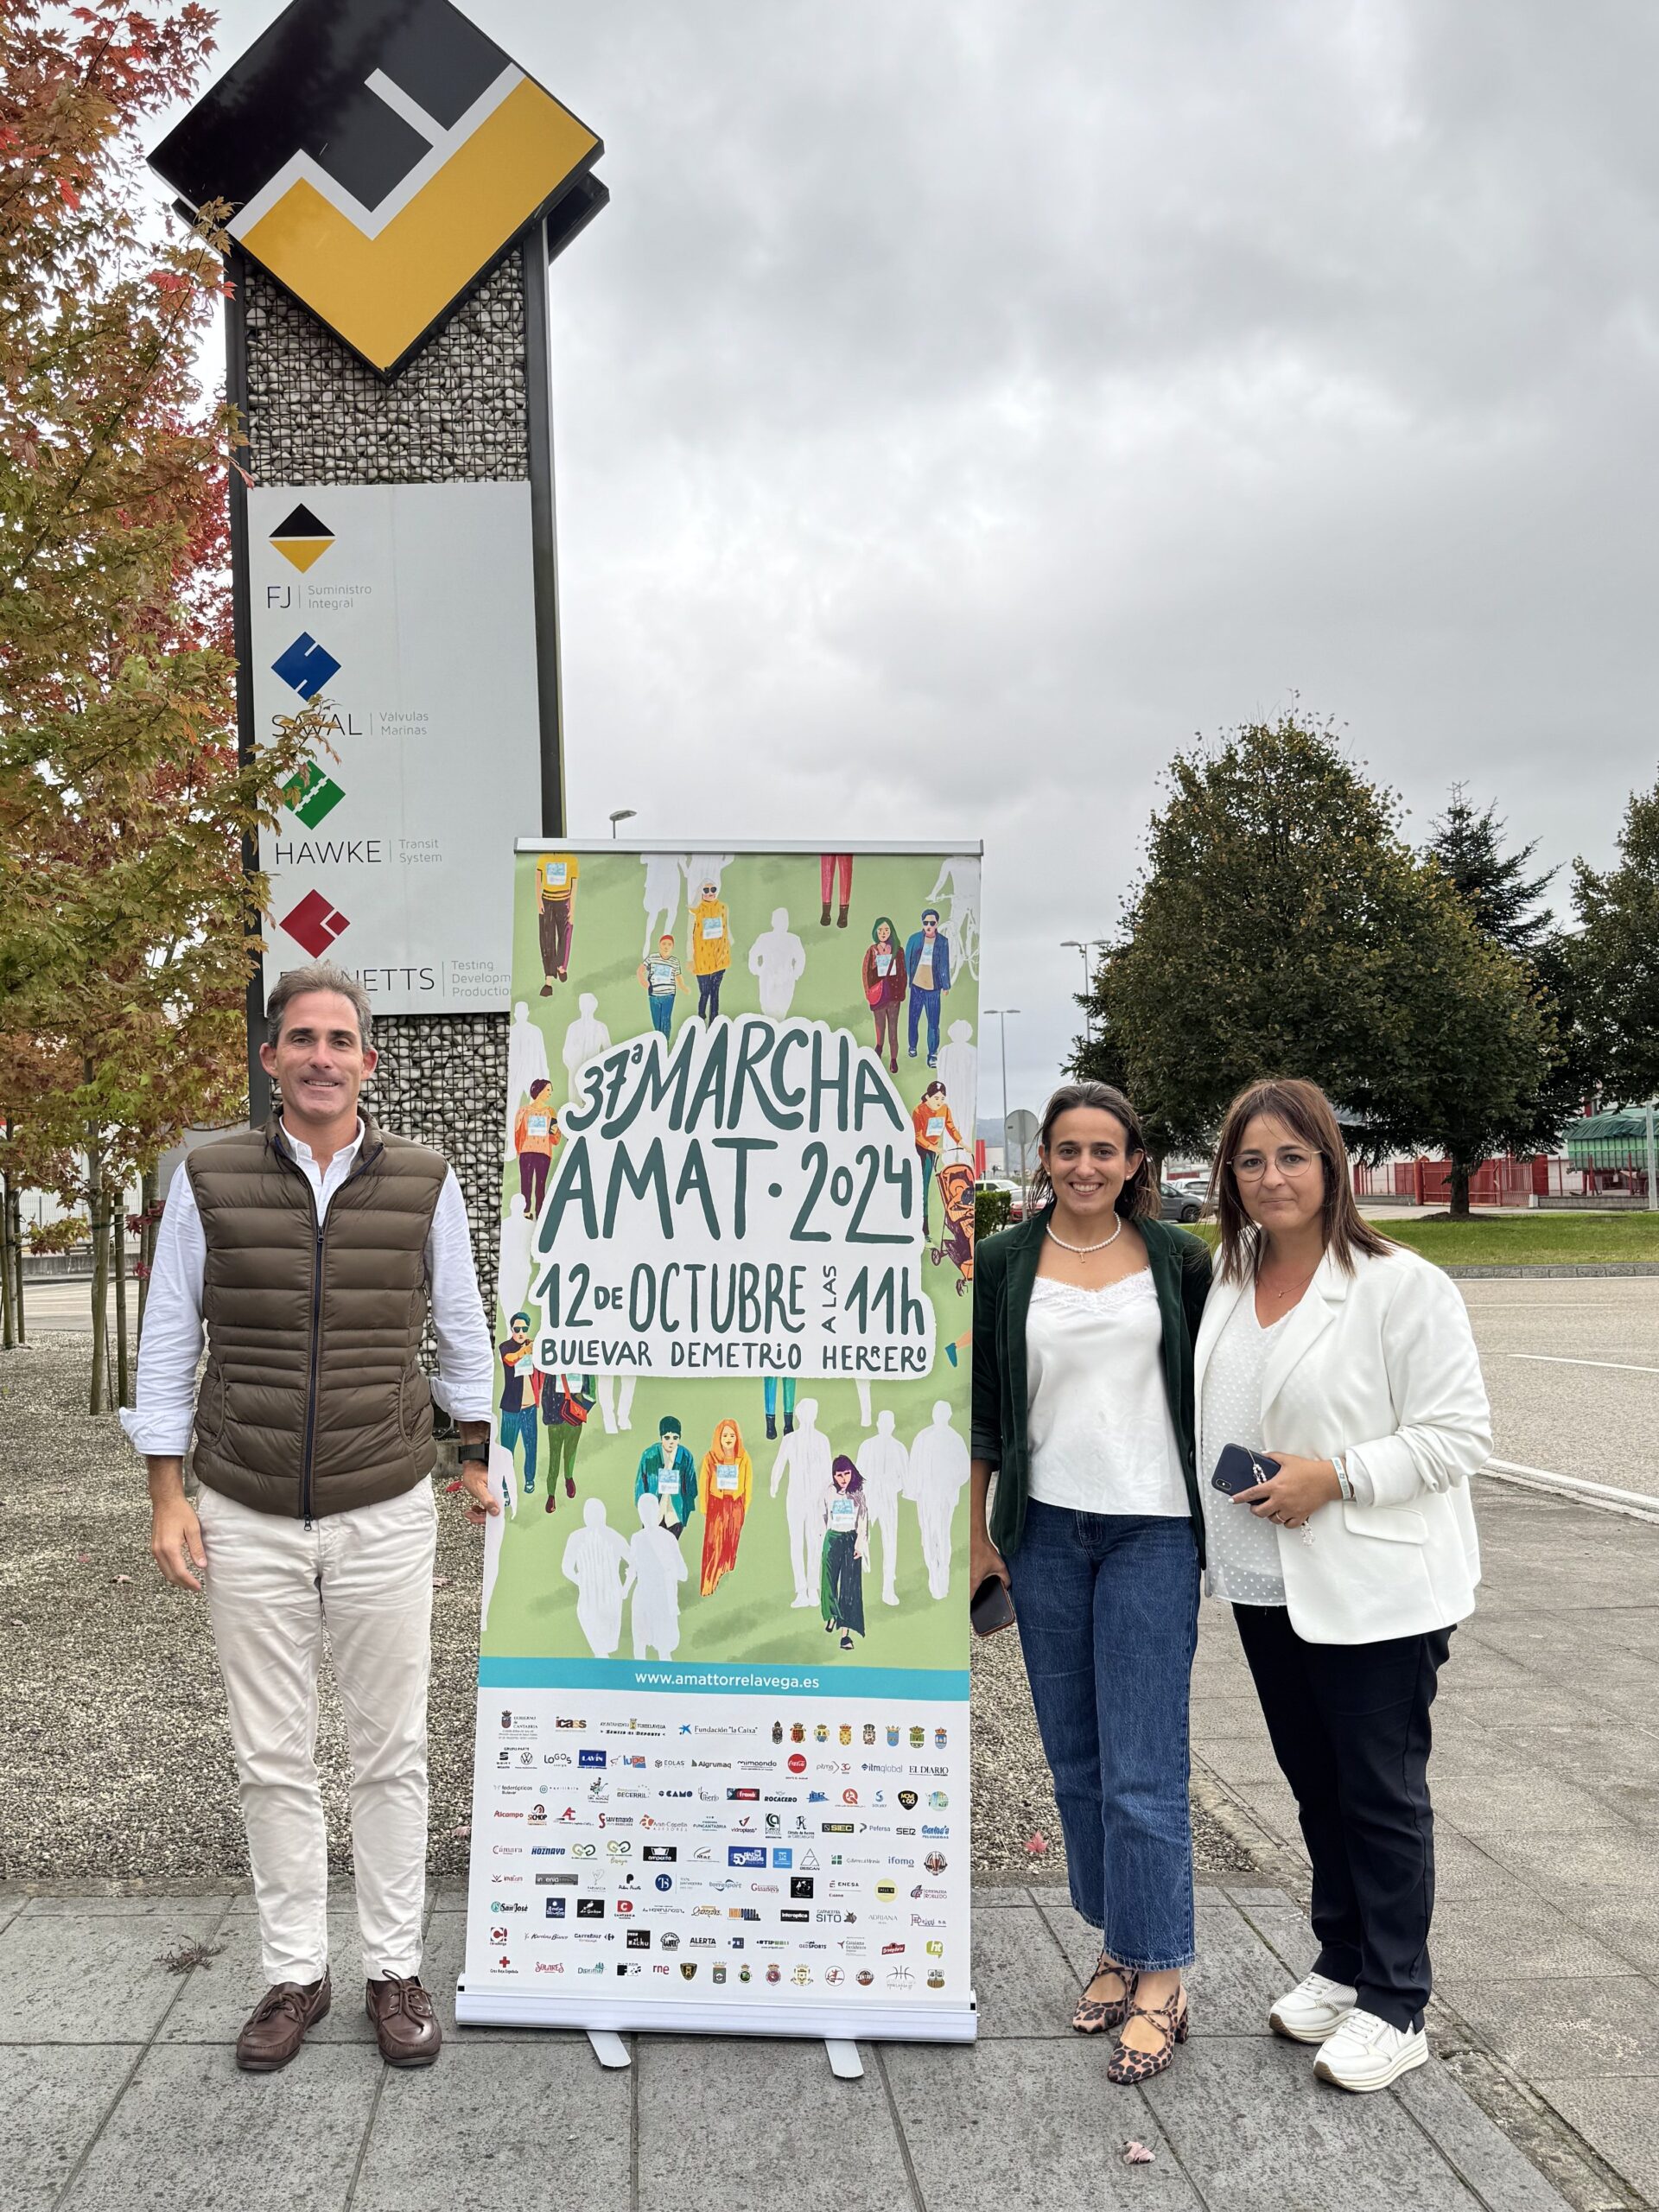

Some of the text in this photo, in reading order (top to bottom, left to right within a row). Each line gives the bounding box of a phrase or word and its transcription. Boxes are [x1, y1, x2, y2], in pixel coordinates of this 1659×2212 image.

[308, 585, 372, 594] Suministro
[267, 586, 290, 608] FJ
[308, 598, 353, 610] Integral
[379, 711, 429, 721] Válvulas
[381, 725, 428, 735] Marinas
[398, 839, 439, 849] Transit
[276, 840, 382, 865] HAWKE
[399, 853, 442, 865] System
[451, 960, 493, 971] Testing
[452, 973, 512, 984] Developm
[601, 1020, 905, 1140] MARCHA
[538, 1136, 914, 1254] AMAT 2024
[536, 1262, 925, 1335] 12 DE OCTUBRE A LAS 11h
[541, 1338, 652, 1367] BULEVAR
[823, 1346, 926, 1372] HERRERO
[635, 1673, 819, 1689] www.amattorrelavega.es
[556, 1716, 587, 1729] icass
[623, 1755, 645, 1765] lupa
[868, 1764, 903, 1774] itmglobal
[921, 1766, 949, 1775] DIARIO
[494, 1810, 524, 1819] Alcampo
[888, 1856, 914, 1866] ifomo
[513, 1903, 528, 1912] José
[536, 1961, 564, 1974] SOLARES
[653, 1965, 670, 1975] rne
